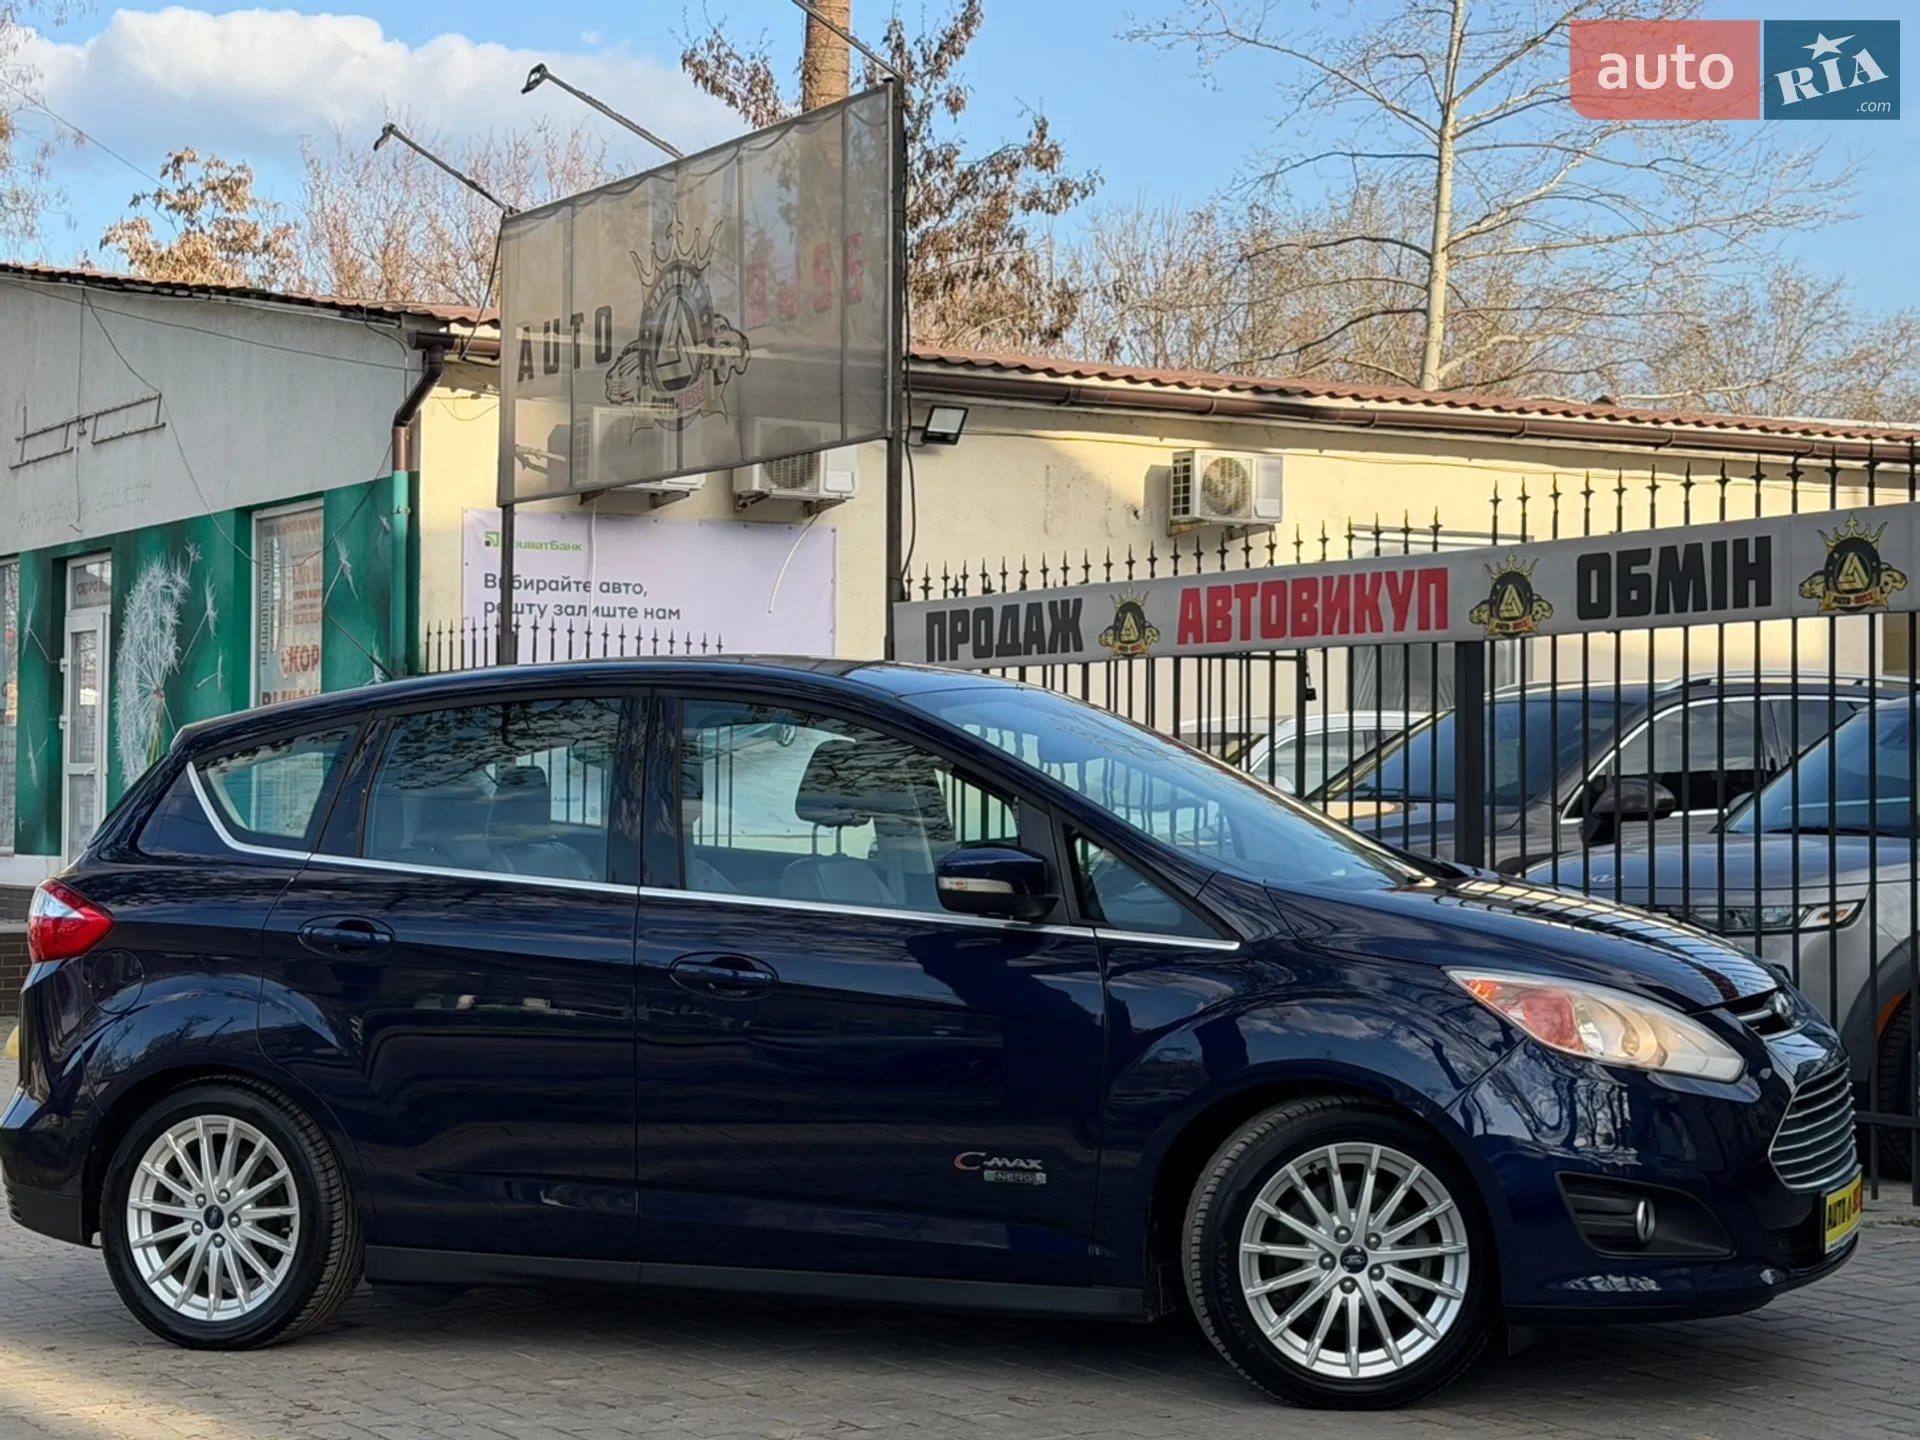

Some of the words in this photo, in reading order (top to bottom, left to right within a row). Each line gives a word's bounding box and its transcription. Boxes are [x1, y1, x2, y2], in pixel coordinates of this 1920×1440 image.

[517, 305, 612, 383] AUTO
[484, 573, 592, 594] Вбирайте
[599, 580, 648, 597] авто,
[926, 598, 1084, 662] ПРОДАЖ
[1177, 567, 1448, 645] АВТОВИКУП
[1577, 535, 1772, 620] ОБМІН
[553, 604, 639, 619] залиште
[644, 607, 681, 620] нам
